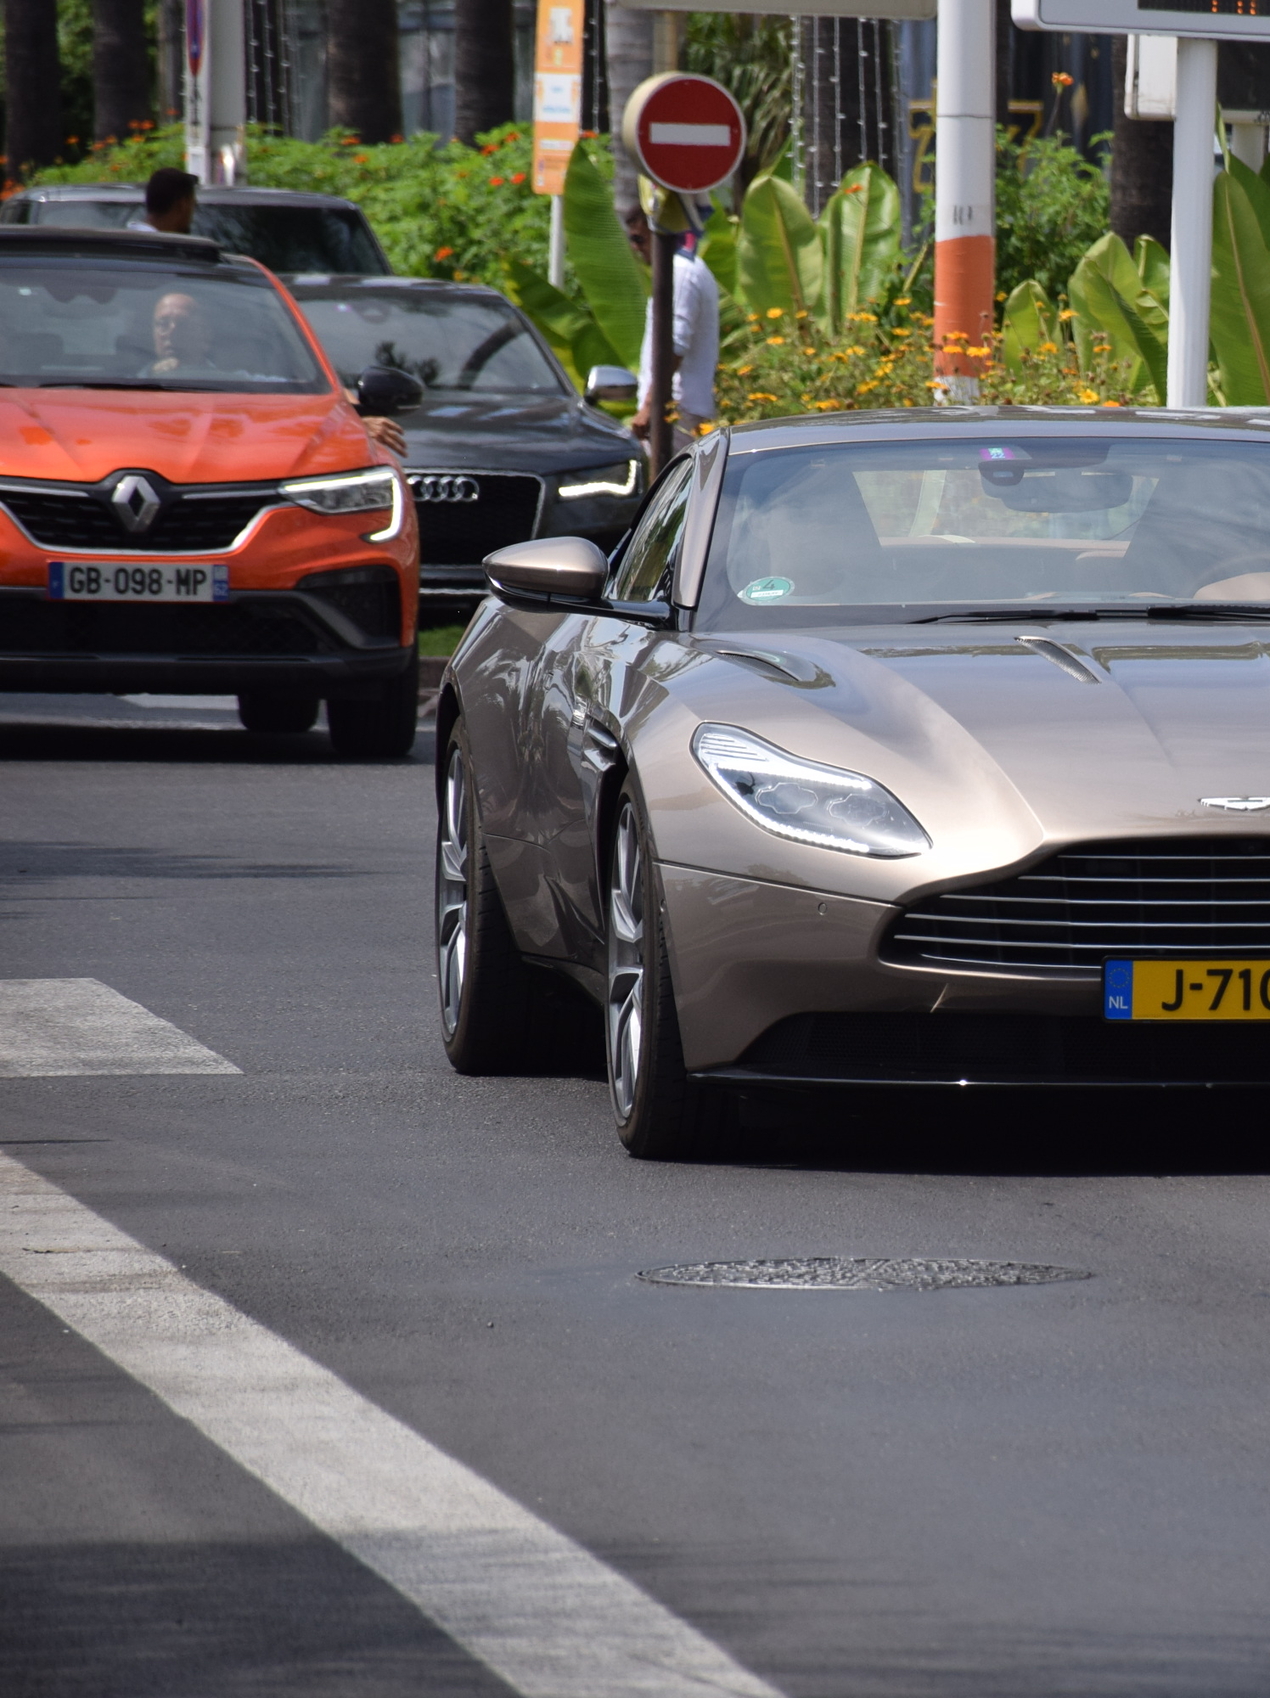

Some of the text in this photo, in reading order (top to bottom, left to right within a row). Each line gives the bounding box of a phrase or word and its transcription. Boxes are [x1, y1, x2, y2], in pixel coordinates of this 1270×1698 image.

[69, 567, 207, 596] GB-098-MP
[763, 579, 776, 590] 4
[1108, 995, 1129, 1010] NL
